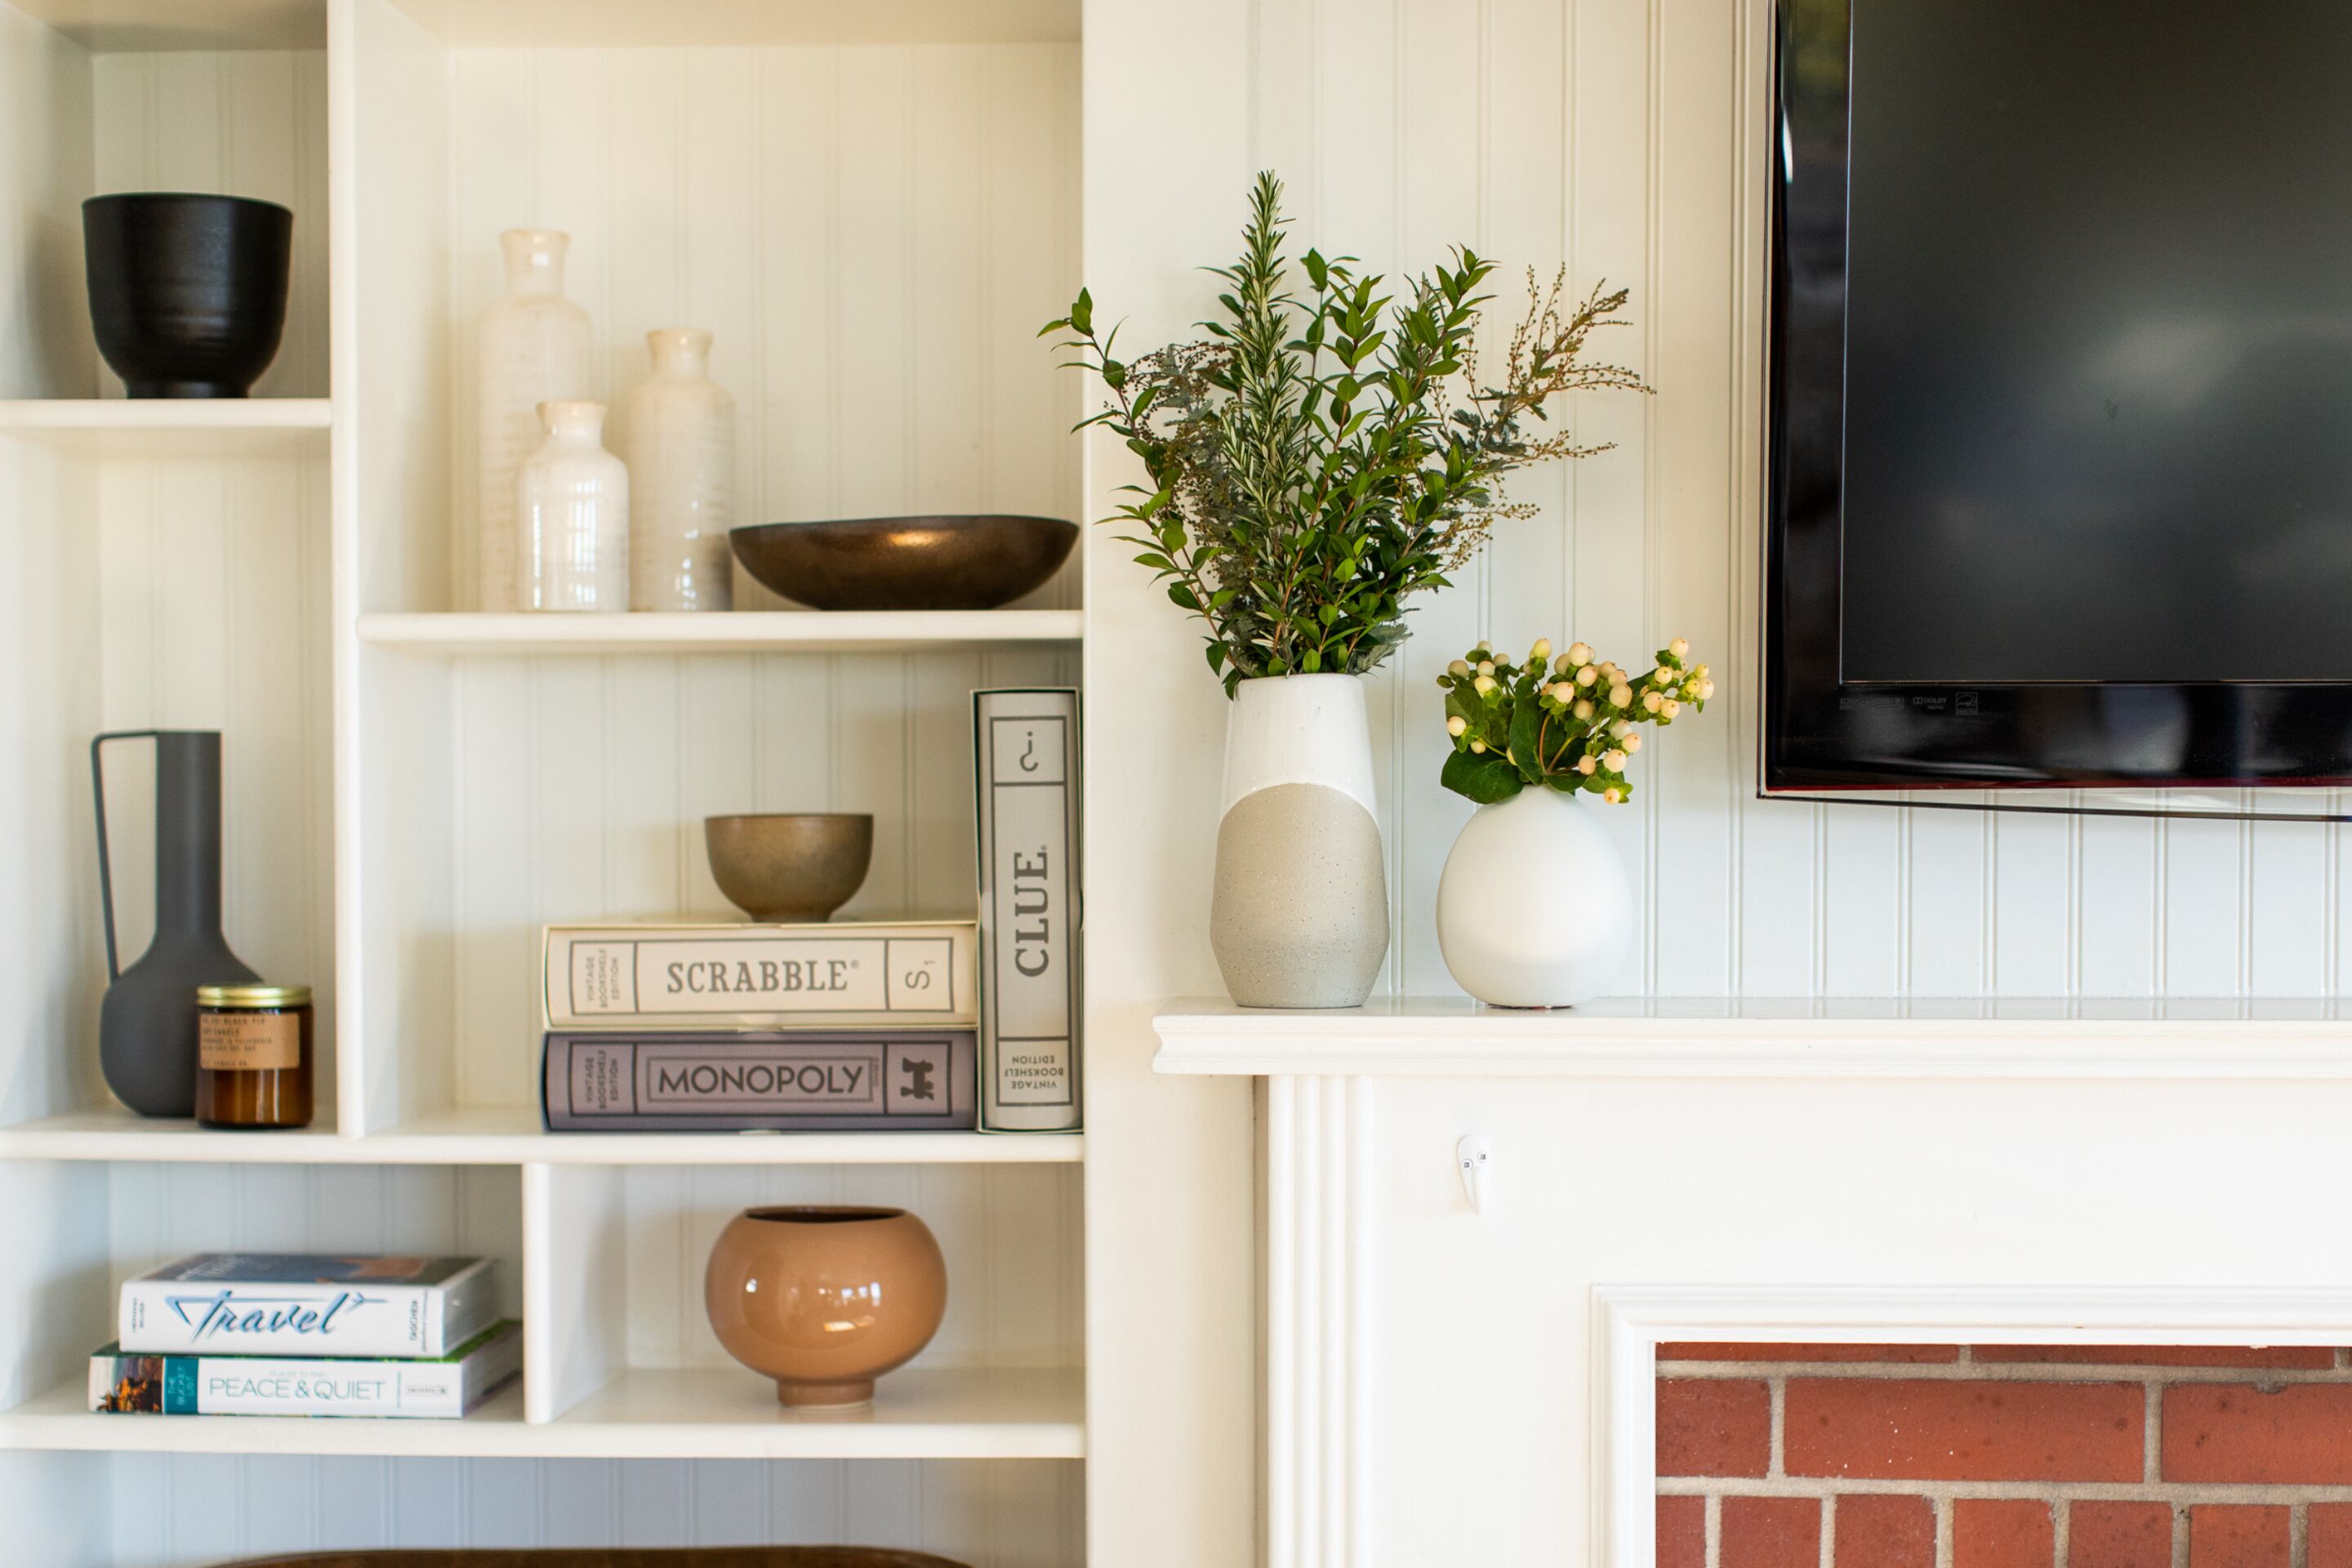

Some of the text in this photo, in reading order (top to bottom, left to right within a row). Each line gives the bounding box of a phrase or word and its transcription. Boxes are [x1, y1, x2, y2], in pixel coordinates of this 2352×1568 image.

[1013, 851, 1049, 978] CLUE
[586, 956, 595, 1002] VINTAGE
[598, 949, 608, 1009] BOOKSHELF
[610, 957, 619, 1000] EDITION
[666, 960, 848, 994] SCRABBLE
[585, 1058, 594, 1103] VINTAGE
[597, 1050, 607, 1110] BOOKSHELF
[609, 1058, 619, 1101] EDITION
[658, 1065, 863, 1094] MONOPOLY
[1004, 1067, 1064, 1077] BOOKSHELF
[1013, 1055, 1055, 1064] EDITION
[1011, 1080, 1058, 1089] VINTAGE
[163, 1288, 388, 1345] Travel
[409, 1299, 418, 1341] TASCHEN
[209, 1378, 290, 1399] PEACE
[295, 1378, 310, 1399] &
[314, 1379, 386, 1401] QUIET
